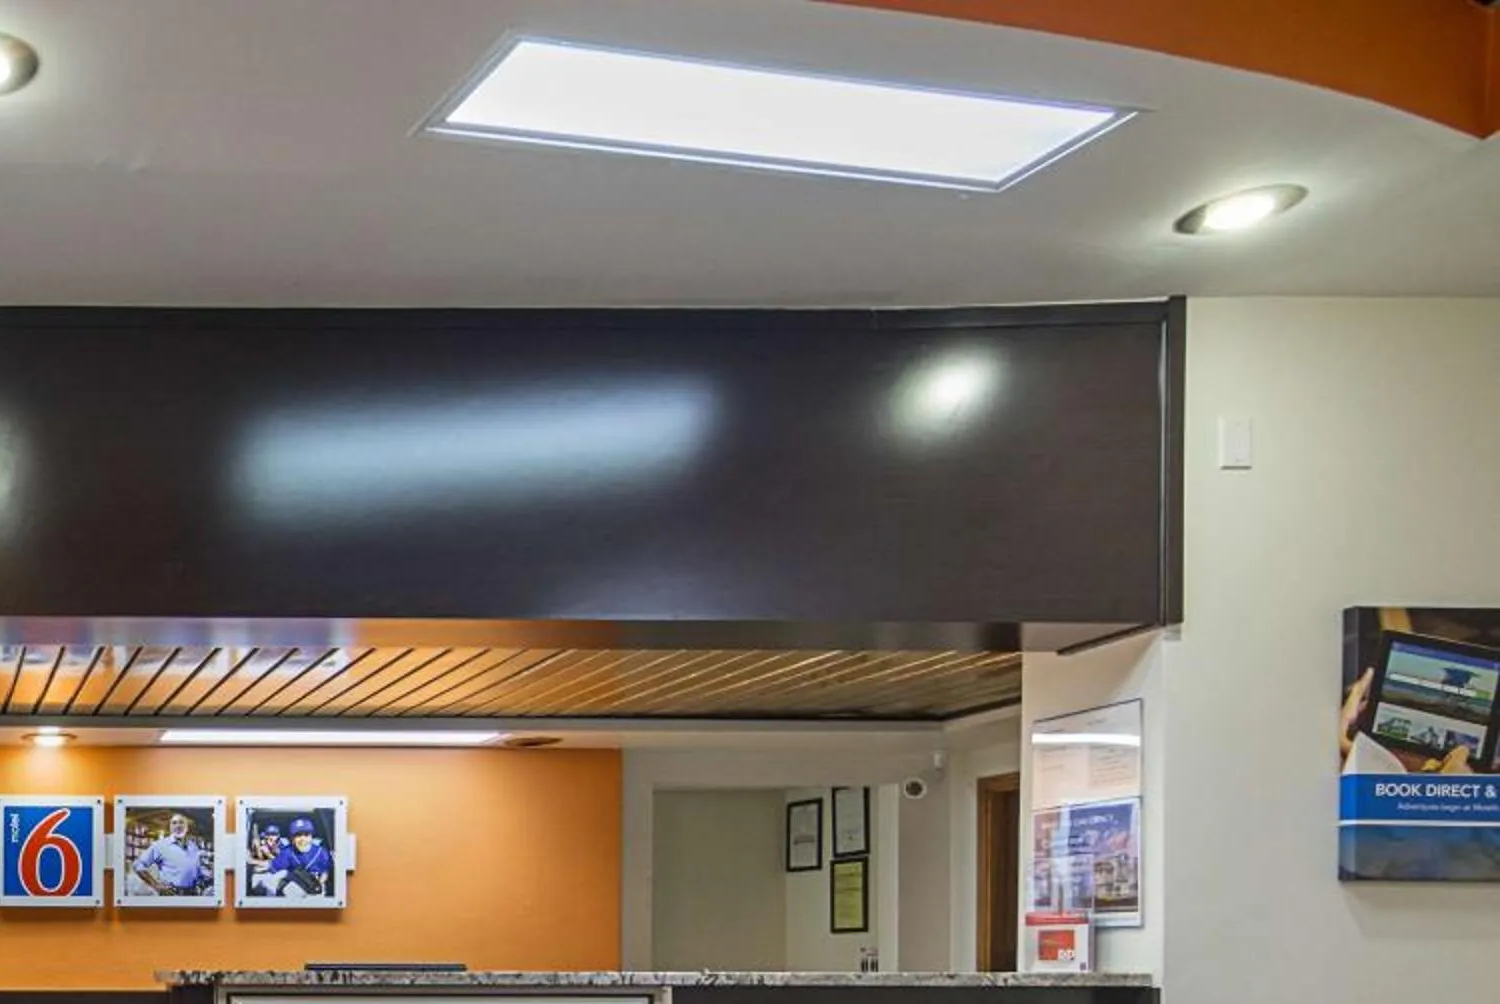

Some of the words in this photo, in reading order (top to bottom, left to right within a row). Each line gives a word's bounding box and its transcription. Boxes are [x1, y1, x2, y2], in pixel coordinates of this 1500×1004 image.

[1375, 783, 1422, 797] BOOK
[1425, 783, 1481, 798] DIRECT
[1484, 784, 1497, 798] &
[18, 808, 83, 896] 6
